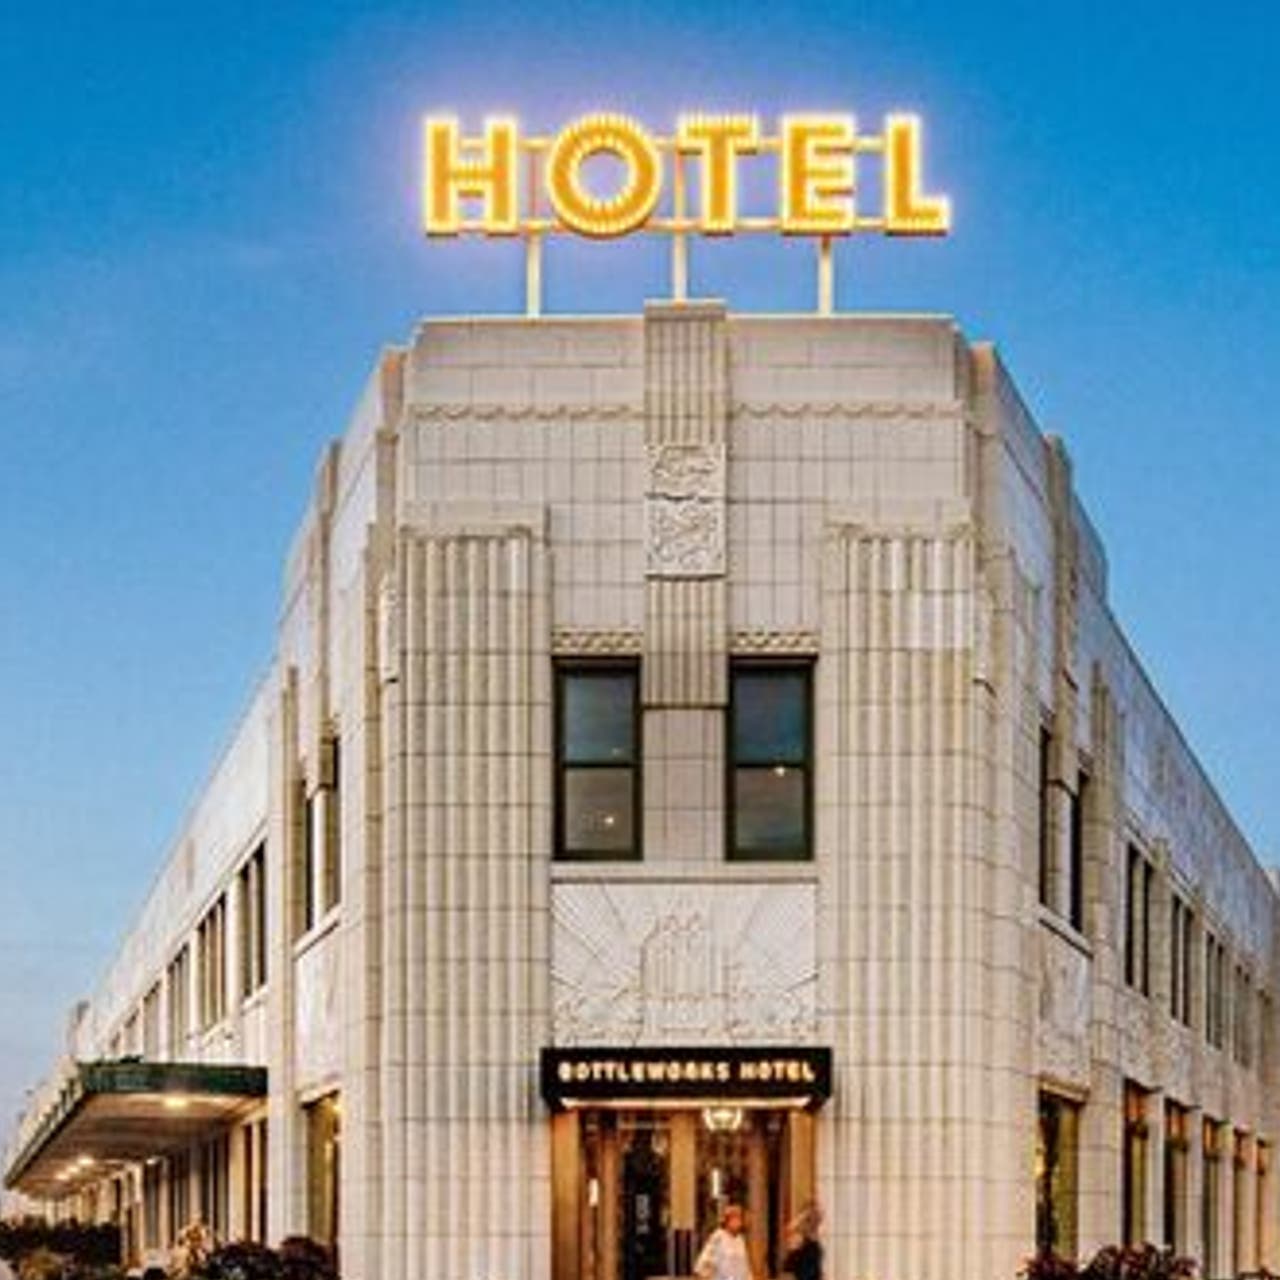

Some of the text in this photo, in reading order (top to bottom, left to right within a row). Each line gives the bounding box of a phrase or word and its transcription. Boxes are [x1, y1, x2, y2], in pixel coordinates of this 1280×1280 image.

[423, 112, 954, 237] HOTEL
[557, 1061, 816, 1083] BOTTLEWORKS HOTEL
